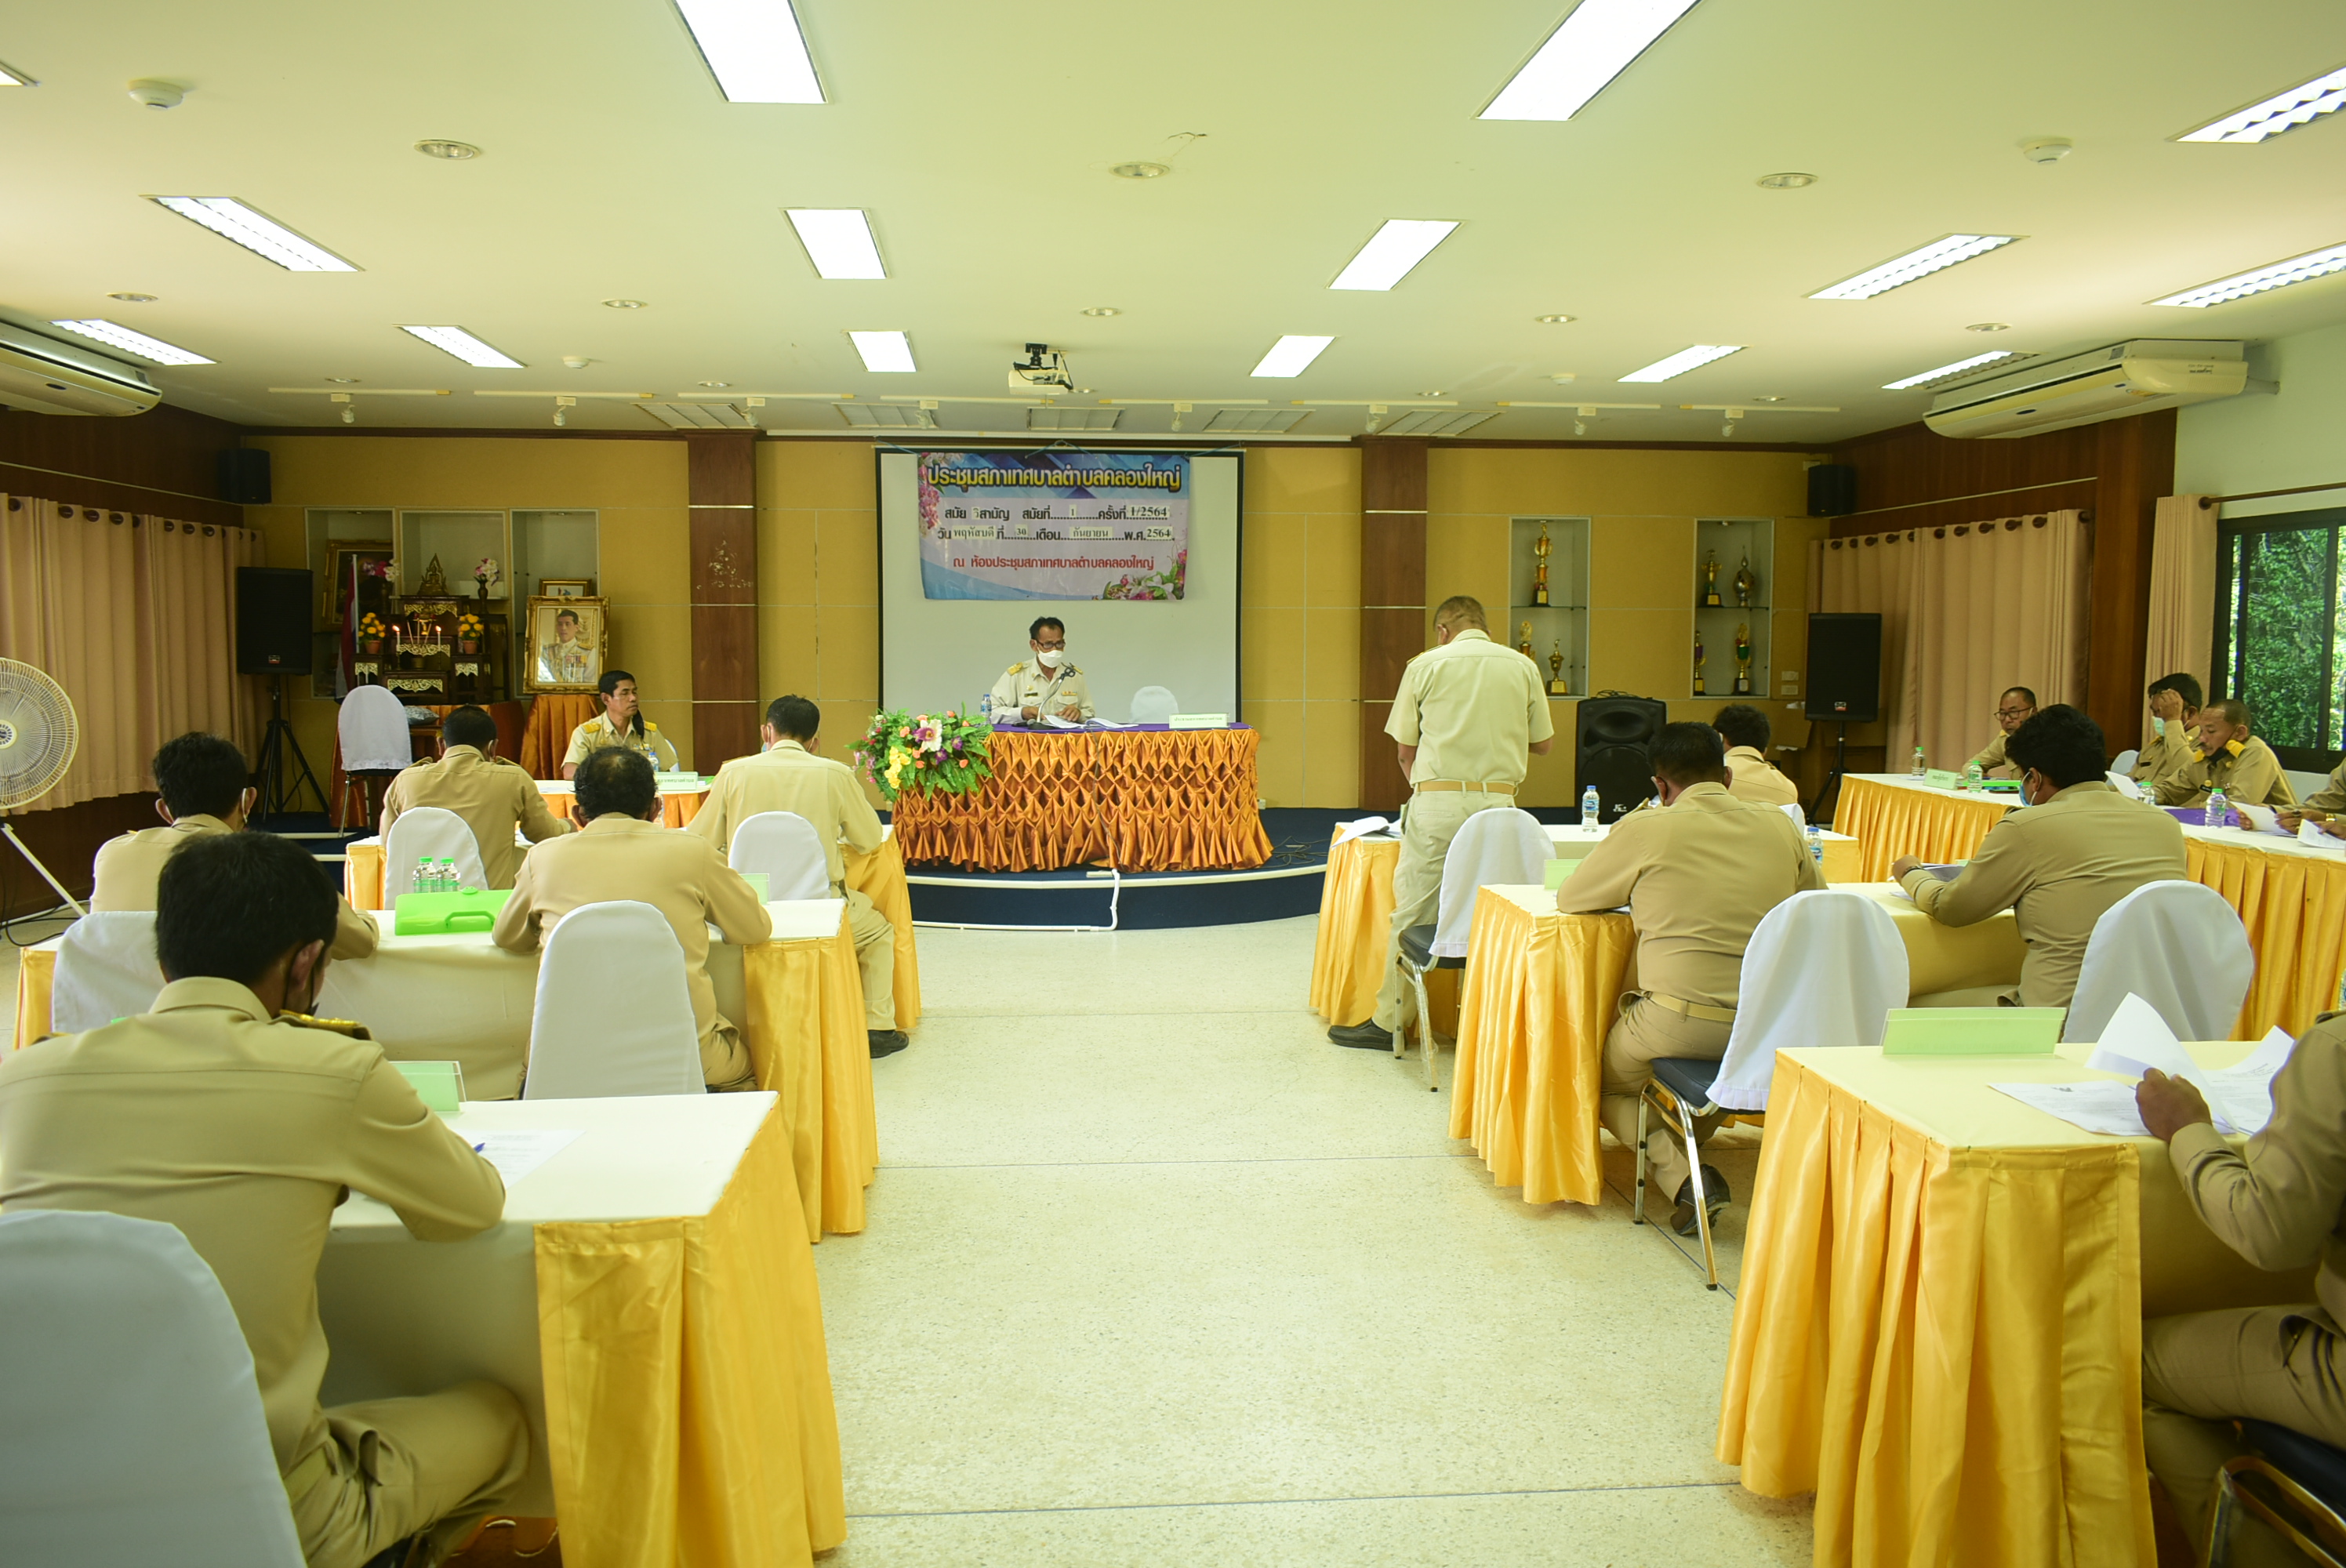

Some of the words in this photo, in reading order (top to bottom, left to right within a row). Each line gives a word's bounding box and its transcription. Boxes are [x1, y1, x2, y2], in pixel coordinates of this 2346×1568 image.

[928, 463, 1181, 492] ประชุมสภาเทศบาลตำบลคลองใหญ่
[944, 506, 967, 520] สมัย
[972, 506, 1010, 521] วิสามัญ
[1130, 506, 1168, 517] 1/2564
[937, 527, 952, 540] วัน
[1016, 528, 1027, 536] 30
[1073, 526, 1109, 538] กันยายน
[1147, 528, 1171, 539] 2564
[953, 557, 965, 568] ณ
[971, 554, 1154, 571] ห้องประชุมสภาเทศบาลตำบลคลองใหญ่
